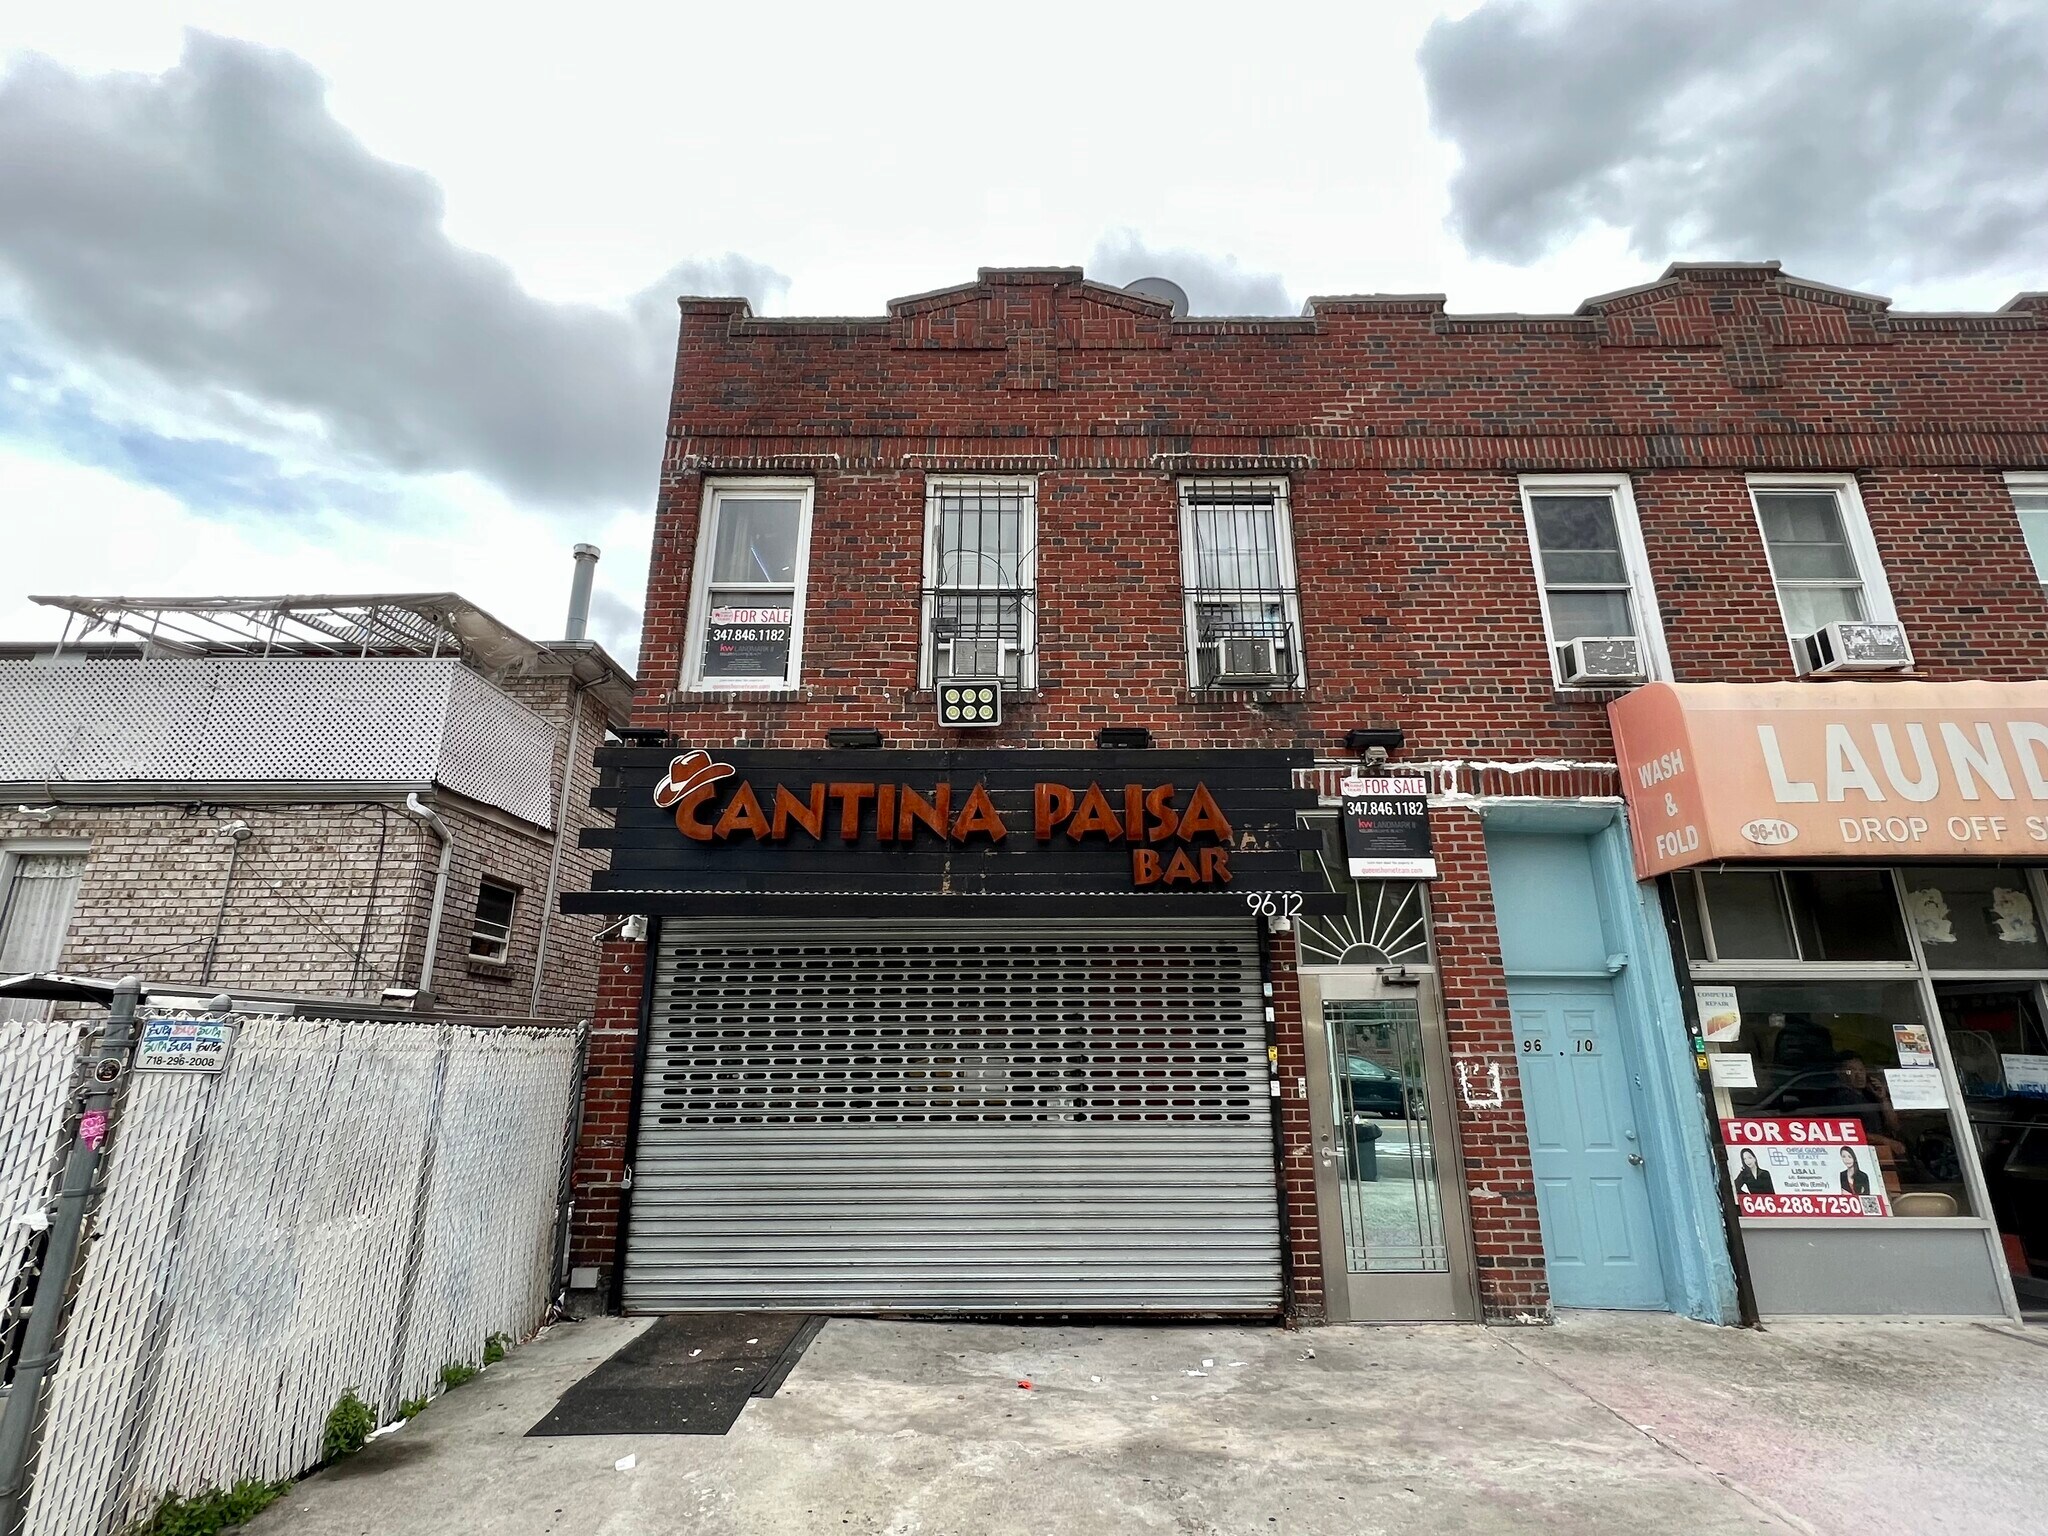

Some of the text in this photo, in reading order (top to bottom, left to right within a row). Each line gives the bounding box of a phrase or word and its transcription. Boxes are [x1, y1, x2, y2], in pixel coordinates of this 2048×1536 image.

[733, 610, 756, 622] FOR
[761, 610, 789, 622] SALE
[713, 629, 785, 641] 347.846.1182
[720, 643, 734, 652] kw
[1638, 749, 1684, 788] WASH
[1365, 780, 1389, 793] FOR
[1394, 780, 1424, 793] SALE
[675, 780, 1234, 843] CANTINA PAISA
[1347, 801, 1424, 815] 347.846.1182
[1664, 793, 1678, 816] &
[1358, 818, 1374, 828] kw
[1374, 821, 1411, 829] LANDMARK
[1839, 816, 2048, 843] DROP OFF S
[1749, 824, 1789, 840] 96-10
[1656, 825, 1699, 859] FOLD
[1133, 847, 1233, 886] BAR
[1523, 1039, 1593, 1052] 96 10
[146, 1056, 215, 1067] 718-296-2008
[1727, 1121, 1859, 1142] FOR SALE
[1743, 1196, 1860, 1214] 646.288.7250
